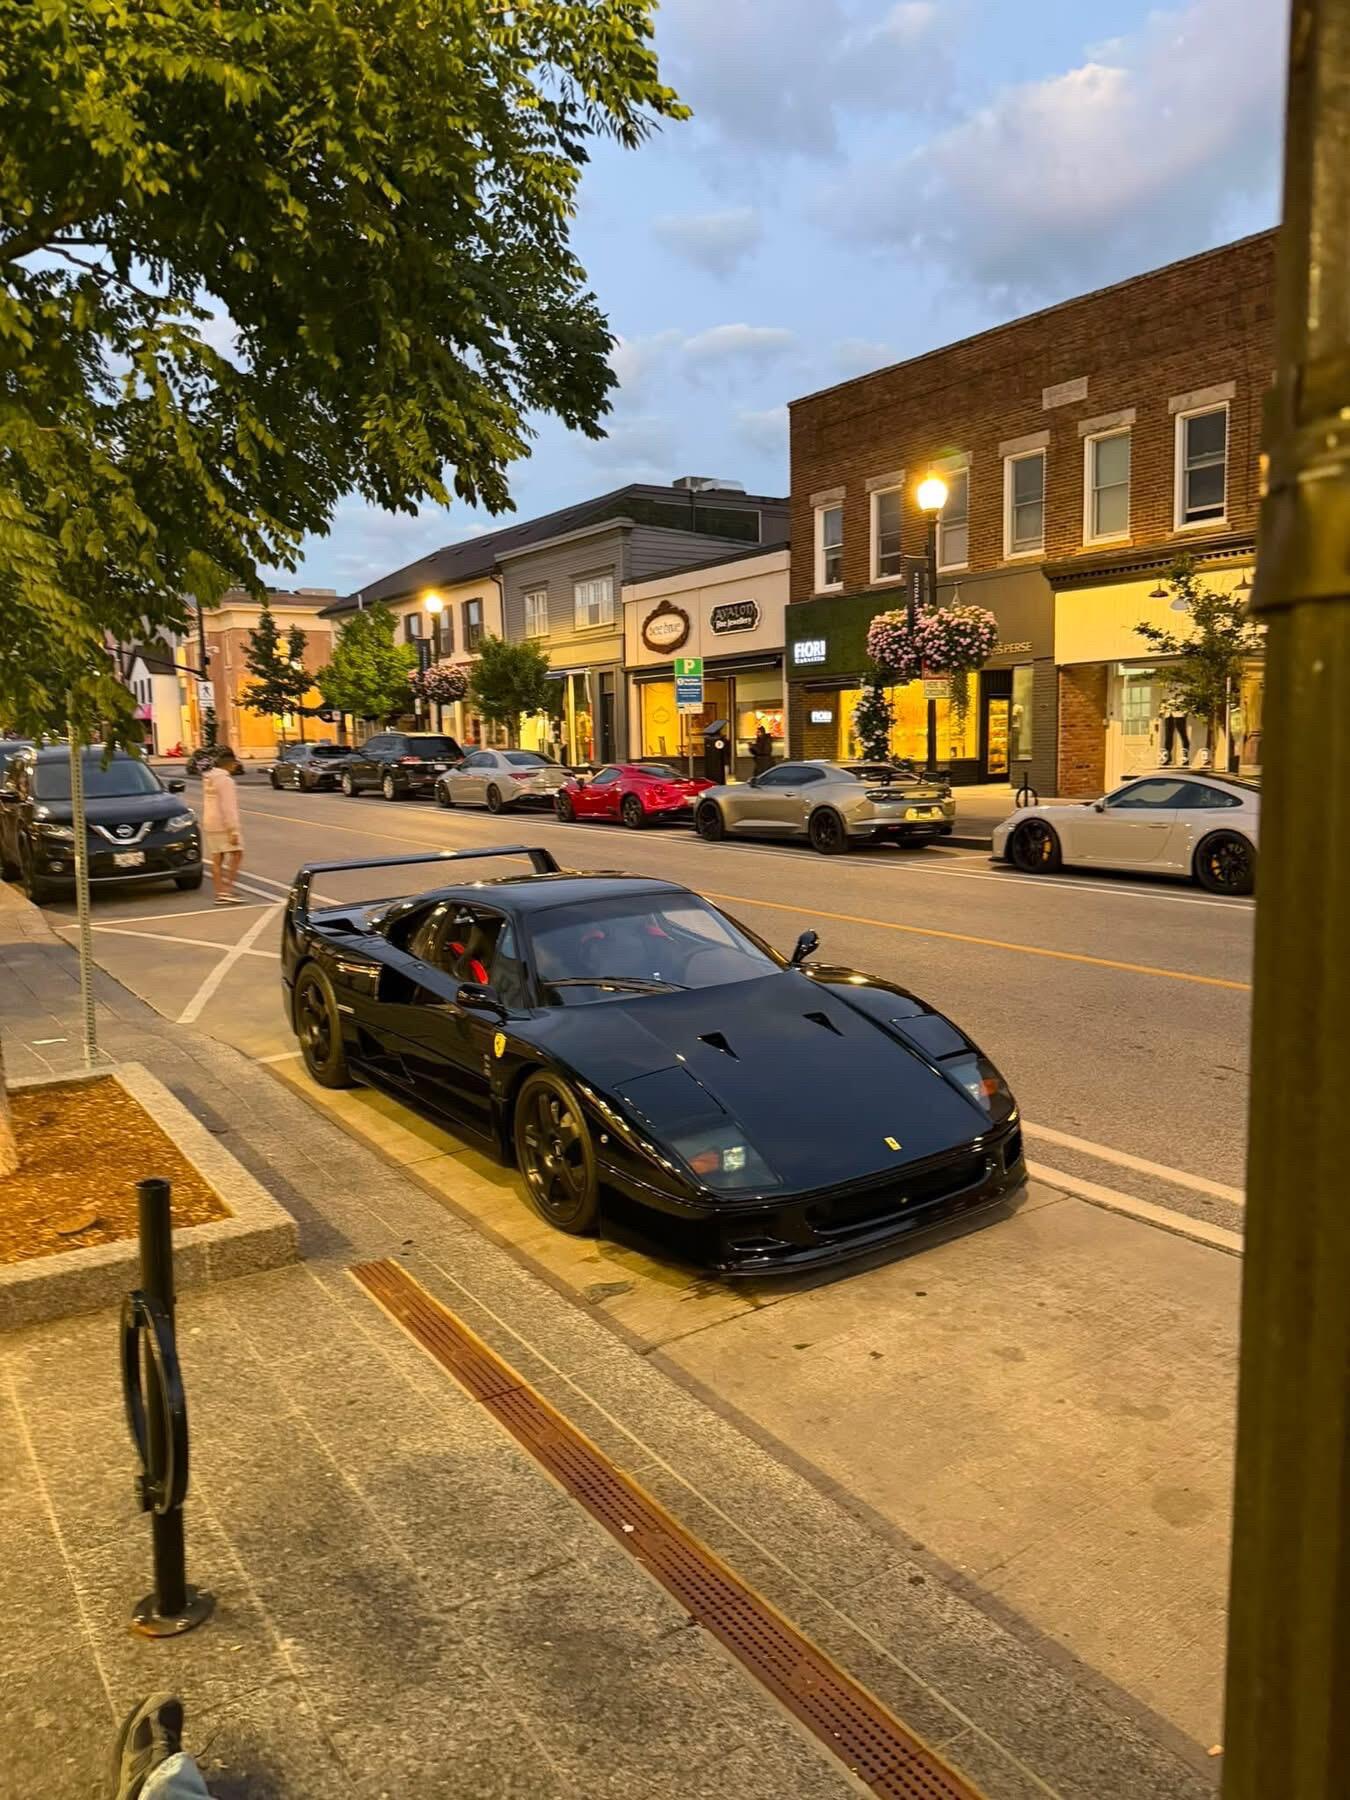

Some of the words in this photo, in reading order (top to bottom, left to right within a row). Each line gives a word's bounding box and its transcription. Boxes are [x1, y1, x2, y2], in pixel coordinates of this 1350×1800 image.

[794, 640, 826, 658] FIORI
[1004, 641, 1033, 654] PERSE
[684, 659, 695, 674] P
